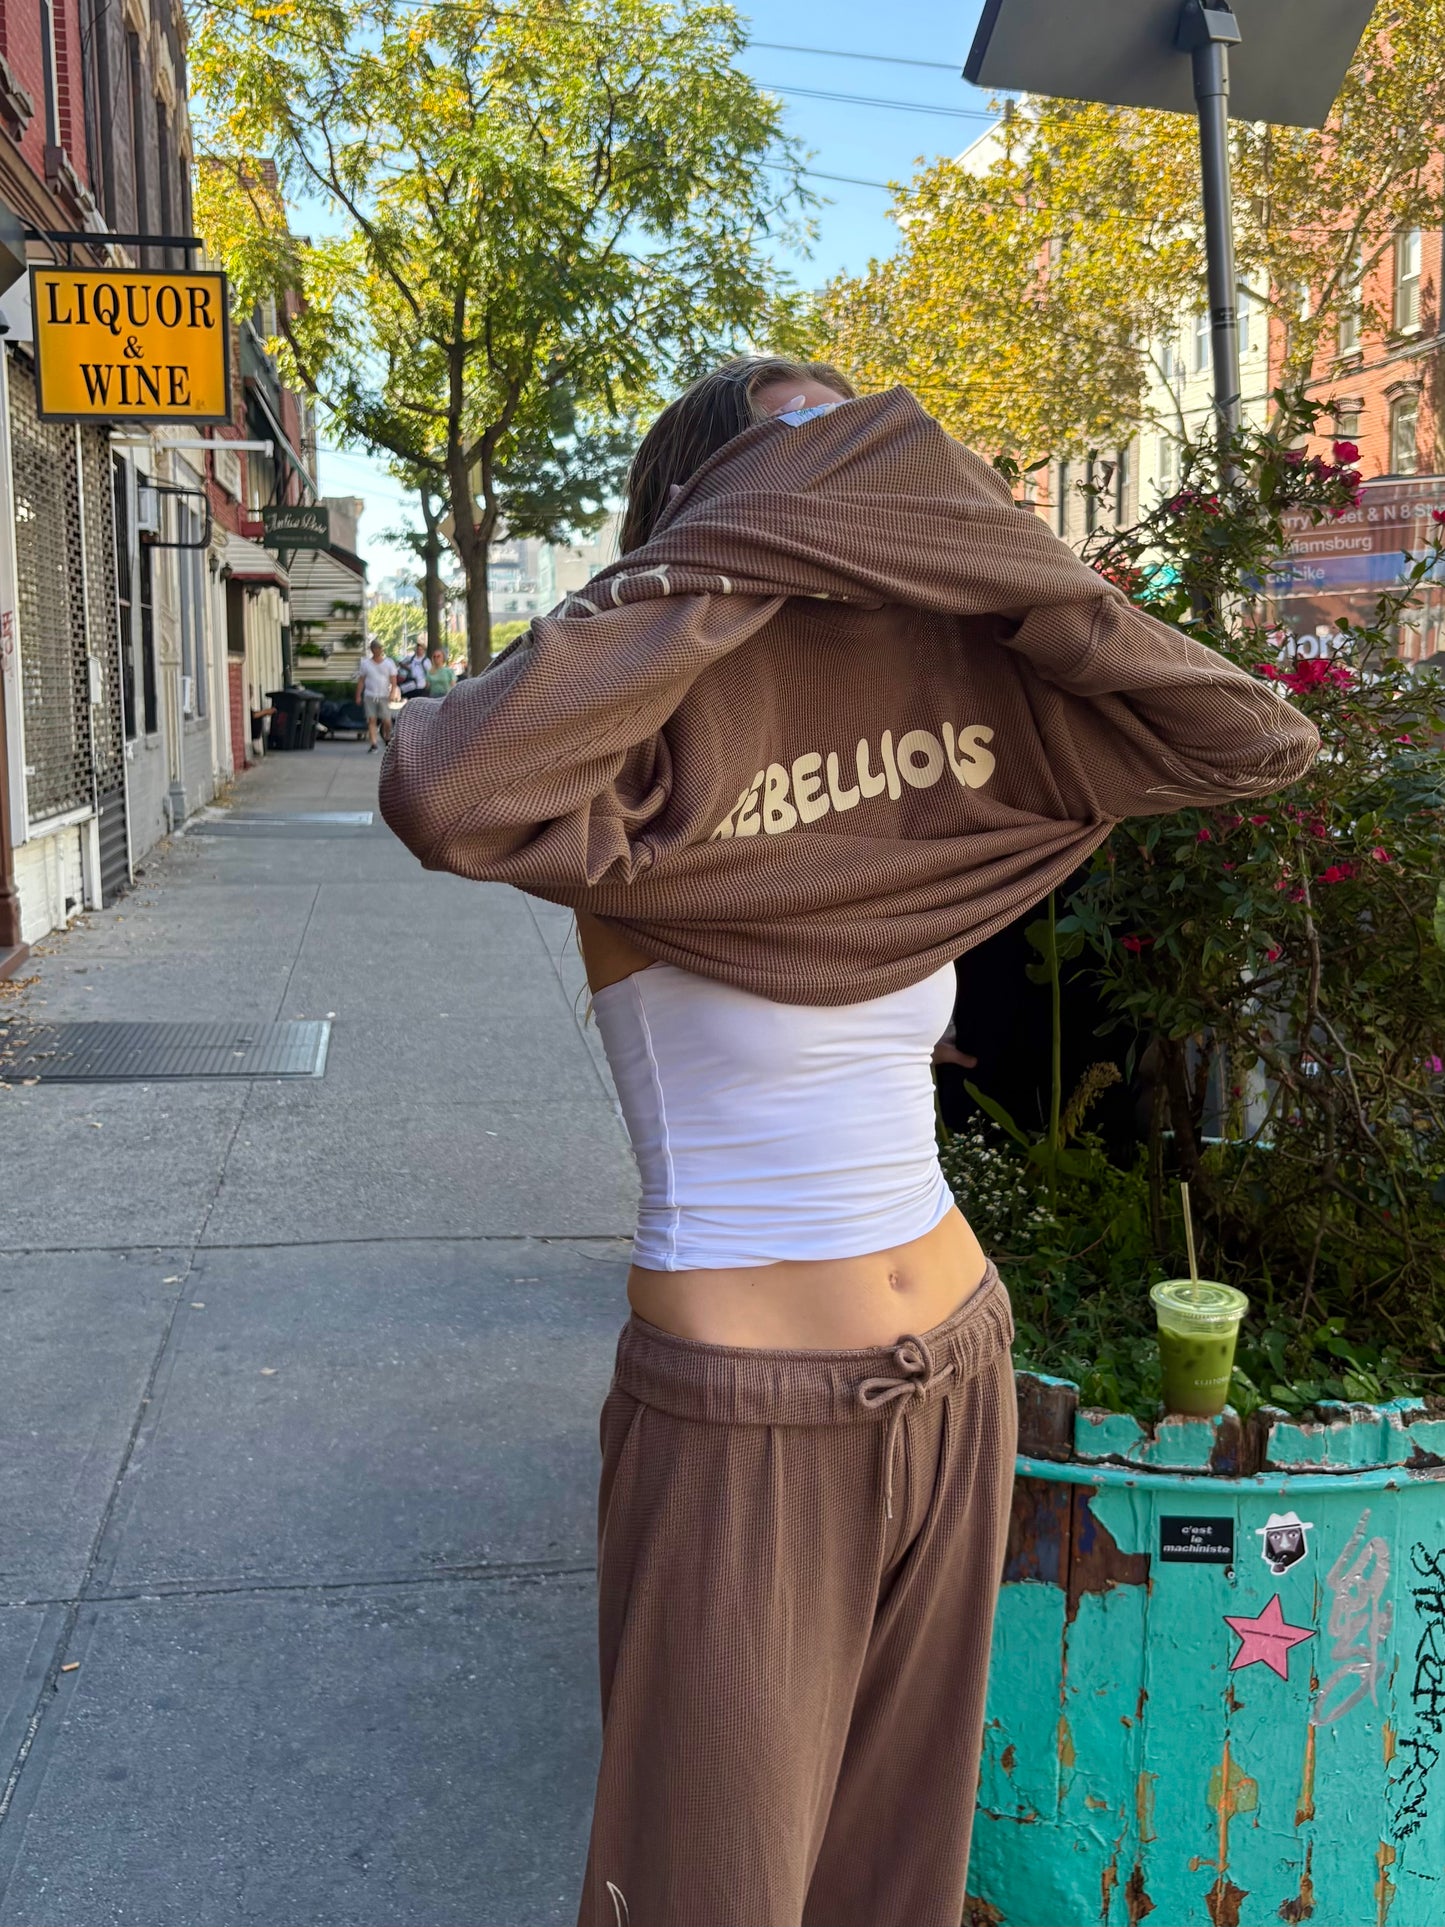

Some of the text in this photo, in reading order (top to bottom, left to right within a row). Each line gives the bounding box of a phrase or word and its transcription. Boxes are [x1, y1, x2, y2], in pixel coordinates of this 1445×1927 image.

[45, 282, 216, 336] LIQUOR
[123, 335, 145, 359] &
[80, 363, 191, 407] WINE
[1367, 506, 1379, 522] &
[1384, 504, 1397, 521] N
[1400, 503, 1411, 519] 8
[1266, 536, 1373, 554] liamsburg
[1163, 1544, 1231, 1554] machiniste
